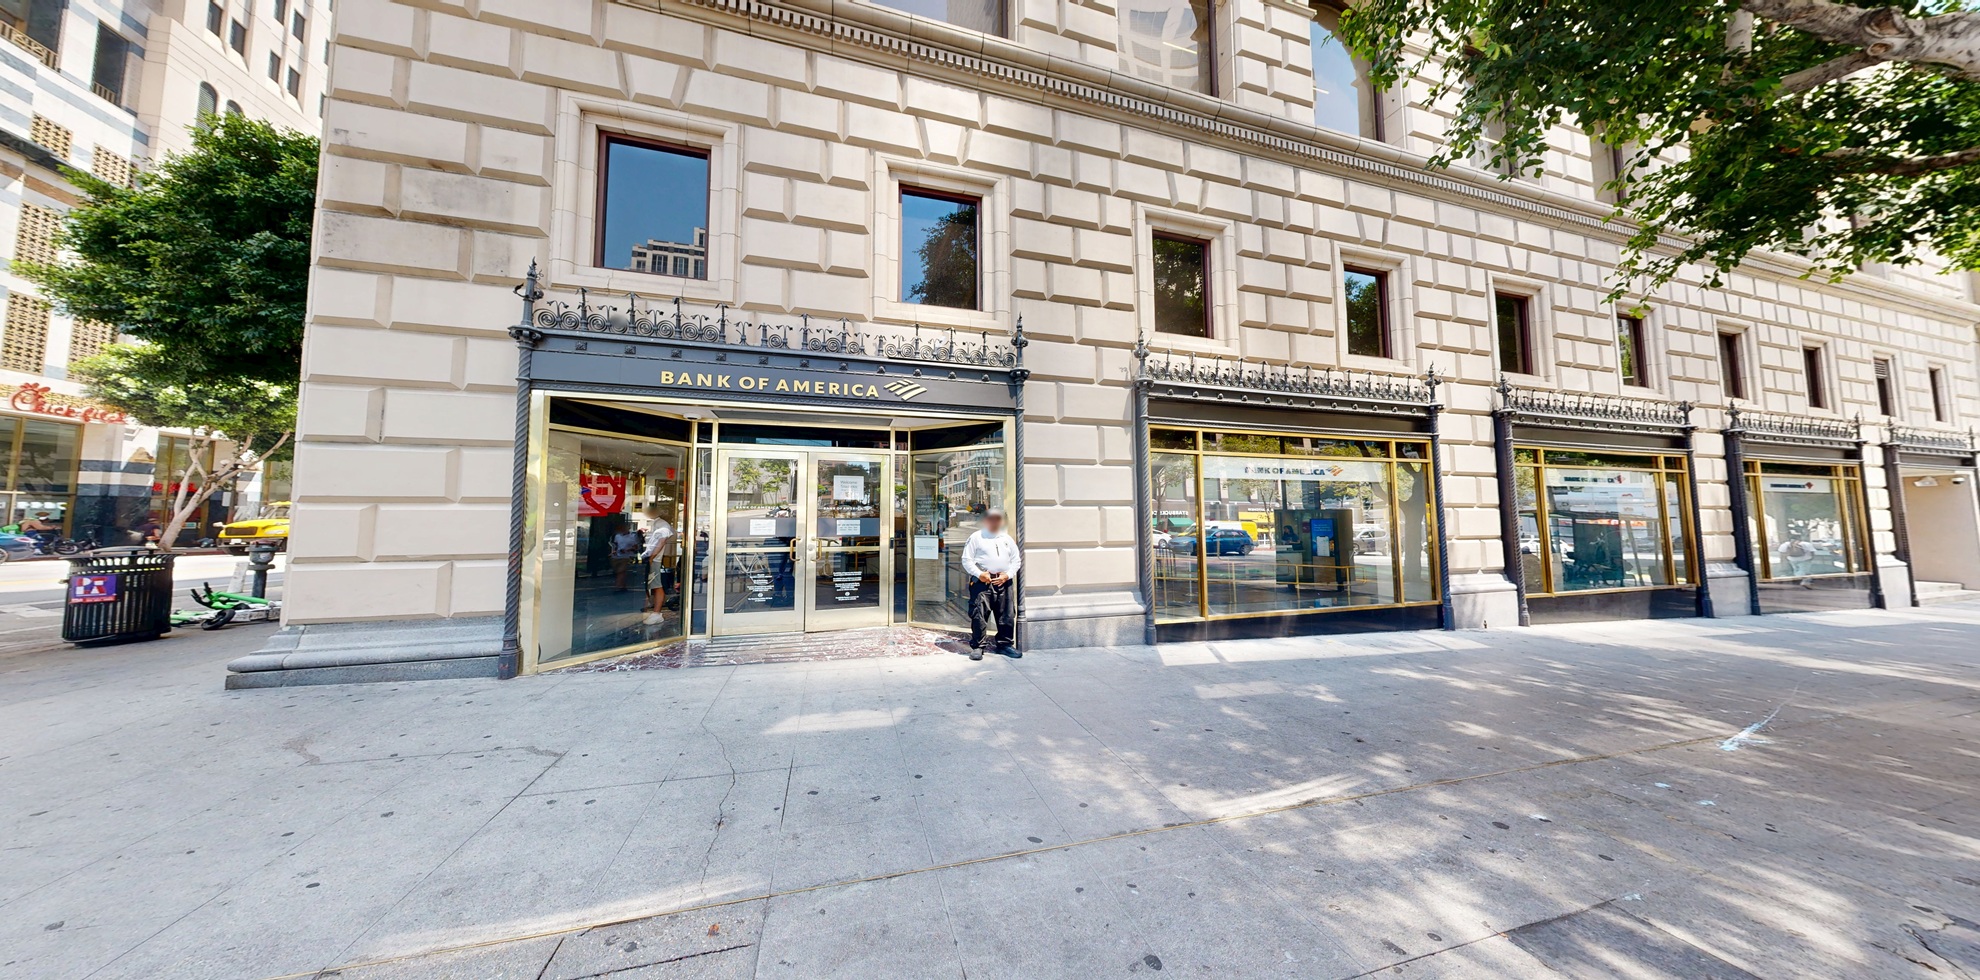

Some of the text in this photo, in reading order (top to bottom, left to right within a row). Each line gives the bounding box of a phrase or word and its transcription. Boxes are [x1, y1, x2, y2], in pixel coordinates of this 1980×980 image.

[660, 371, 879, 398] BANK OF AMERICA
[1244, 466, 1270, 474] BNK
